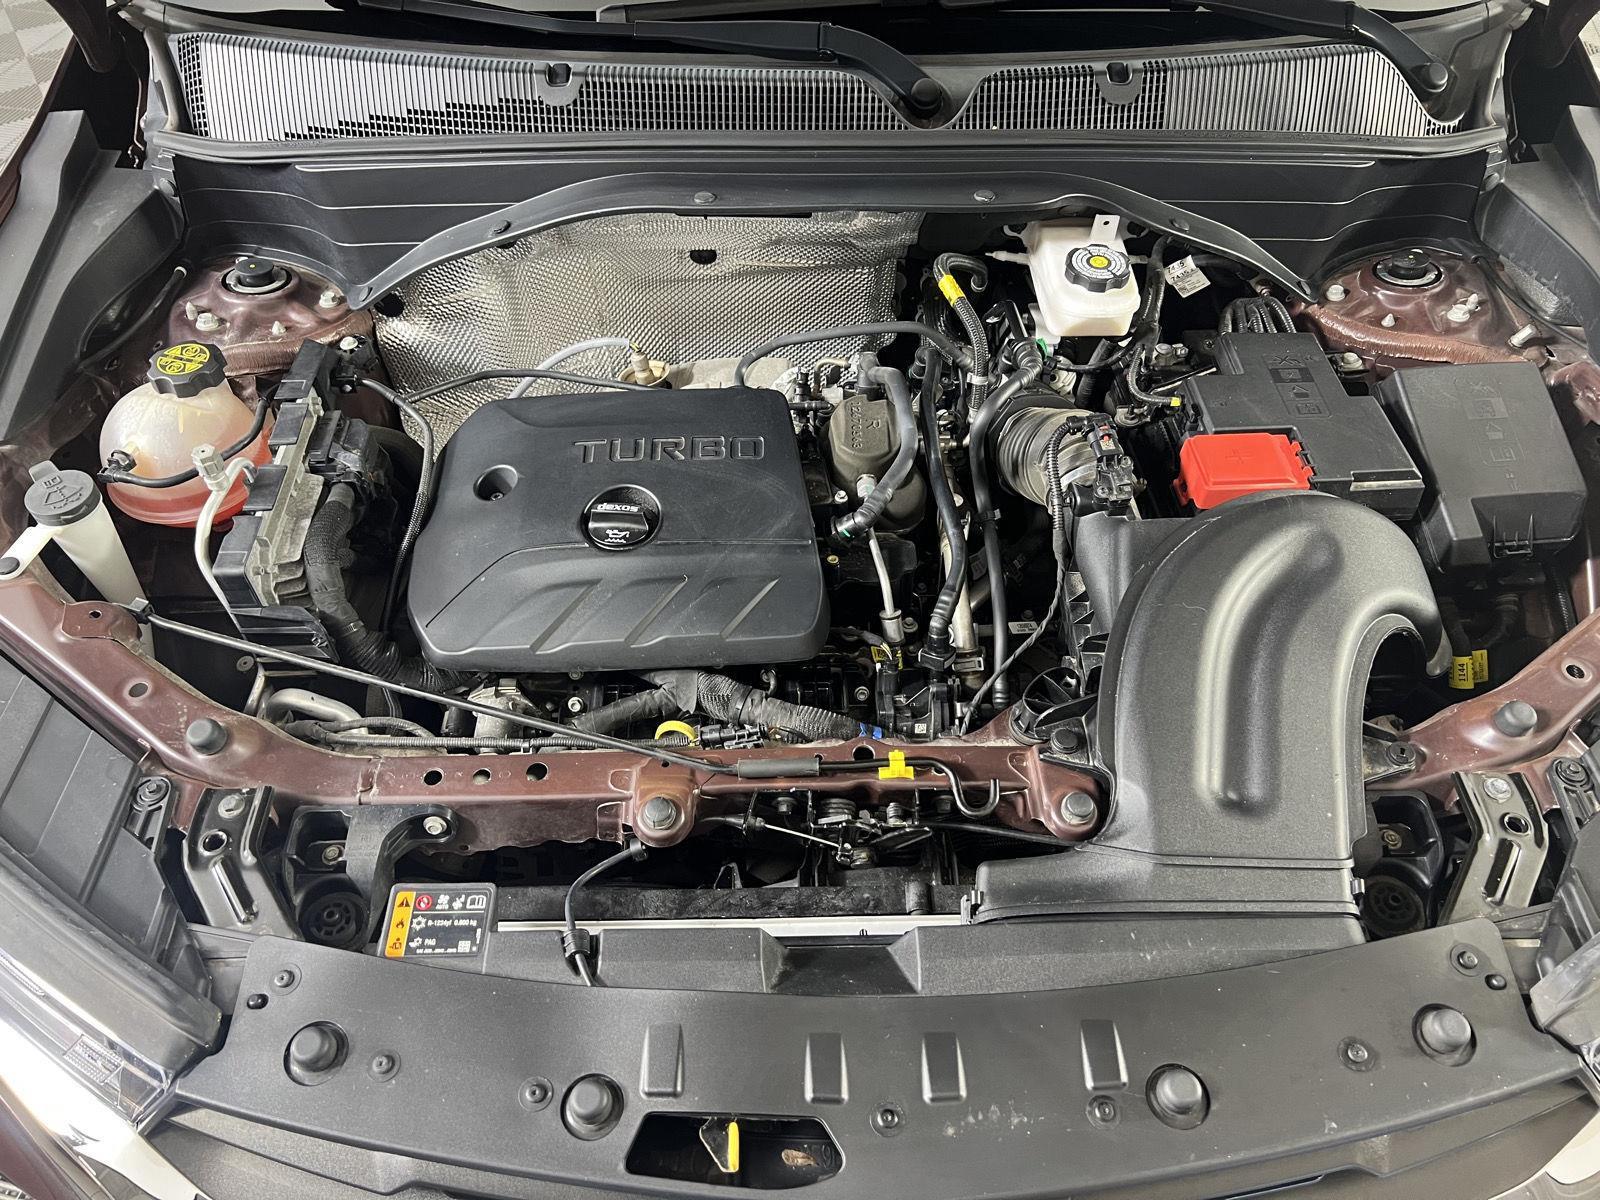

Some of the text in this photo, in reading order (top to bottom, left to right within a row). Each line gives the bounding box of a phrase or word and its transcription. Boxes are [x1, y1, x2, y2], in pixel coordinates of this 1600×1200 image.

[573, 436, 765, 464] TURBO
[597, 502, 640, 513] dexos
[1457, 663, 1466, 682] 1144
[470, 918, 477, 927] kg
